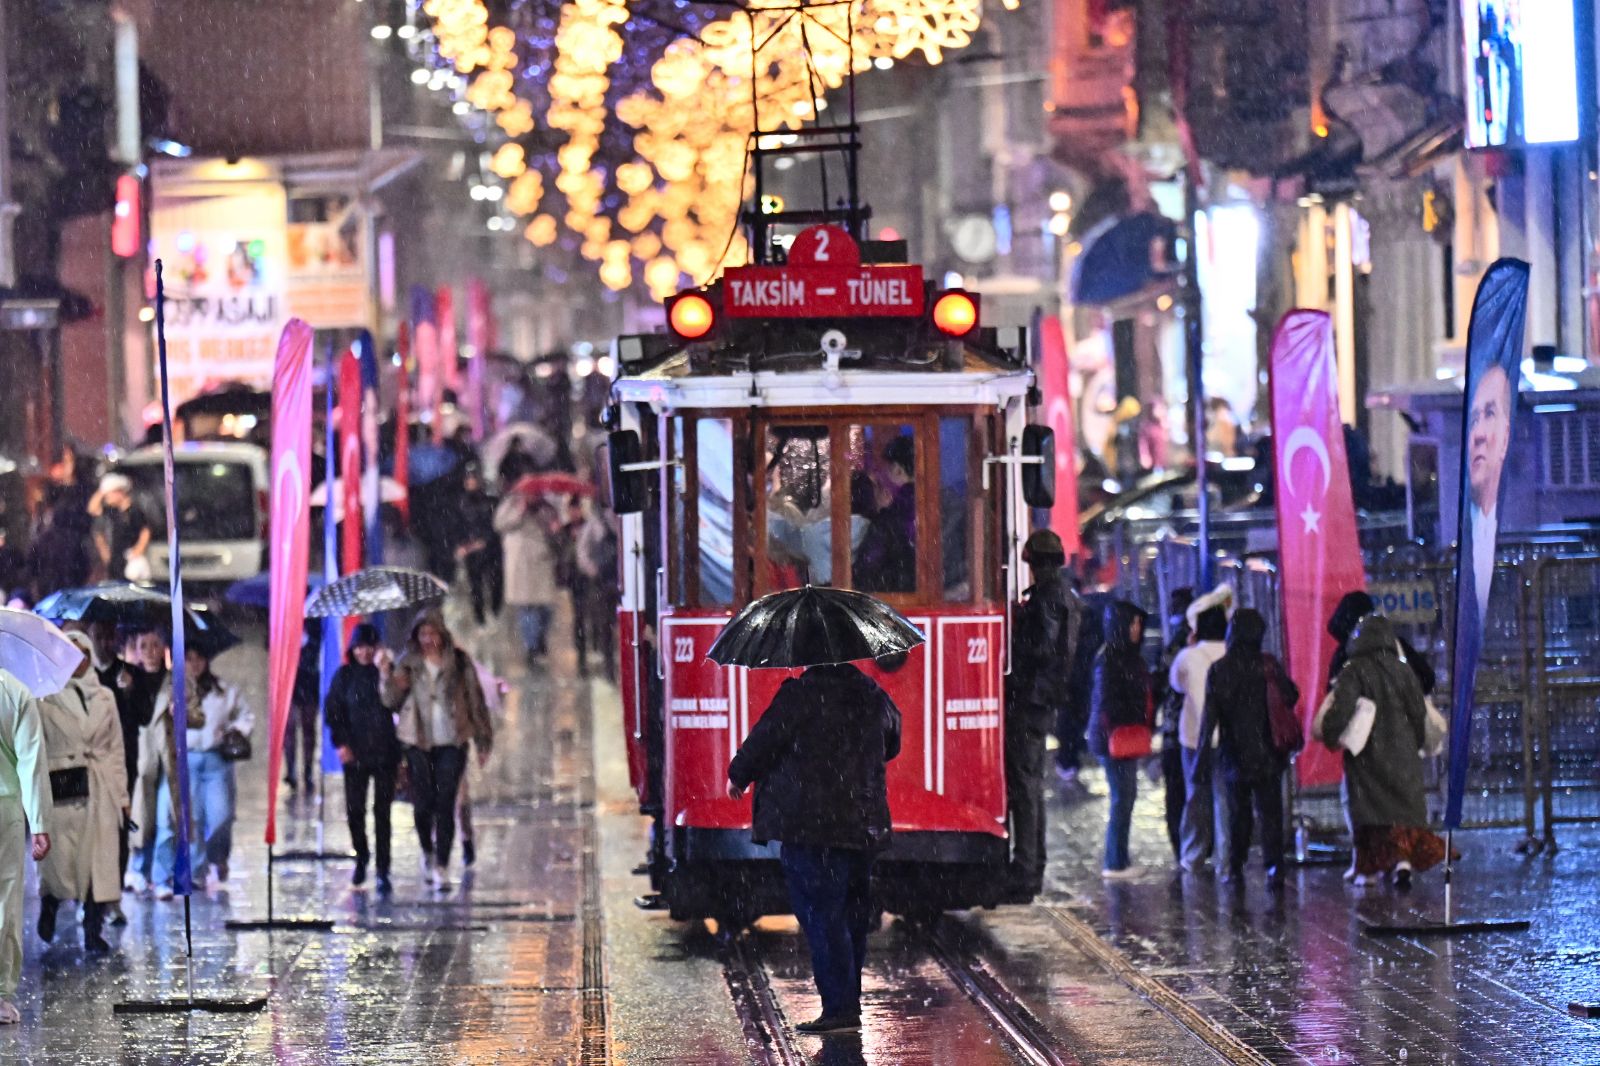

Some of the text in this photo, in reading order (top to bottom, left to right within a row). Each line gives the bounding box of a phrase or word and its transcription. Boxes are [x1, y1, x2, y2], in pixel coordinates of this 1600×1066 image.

[814, 229, 829, 261] 2
[730, 274, 805, 306] TAKSİM
[847, 273, 912, 305] TÜNEL
[675, 637, 694, 662] 223
